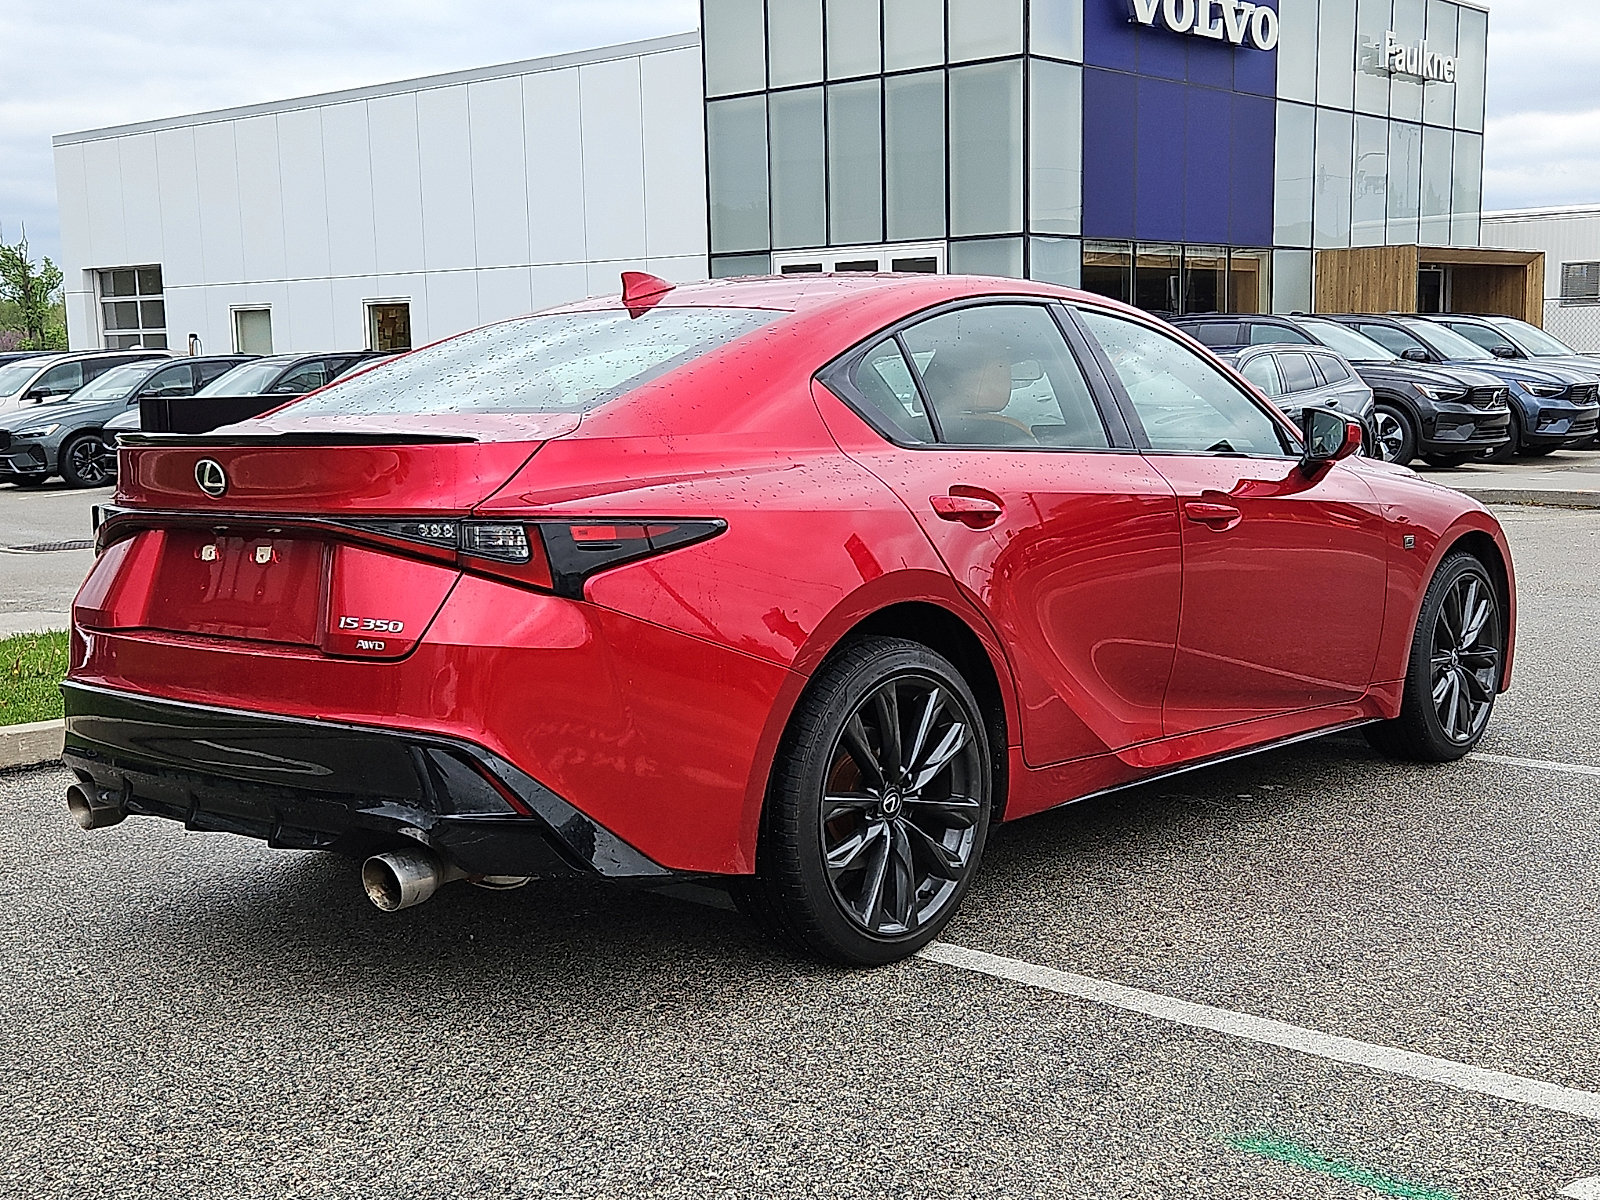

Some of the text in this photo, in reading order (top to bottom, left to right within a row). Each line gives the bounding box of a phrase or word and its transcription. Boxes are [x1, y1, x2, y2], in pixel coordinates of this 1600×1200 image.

[1130, 0, 1279, 51] VOLVO
[338, 616, 404, 633] IS 350
[355, 639, 385, 651] AWD
